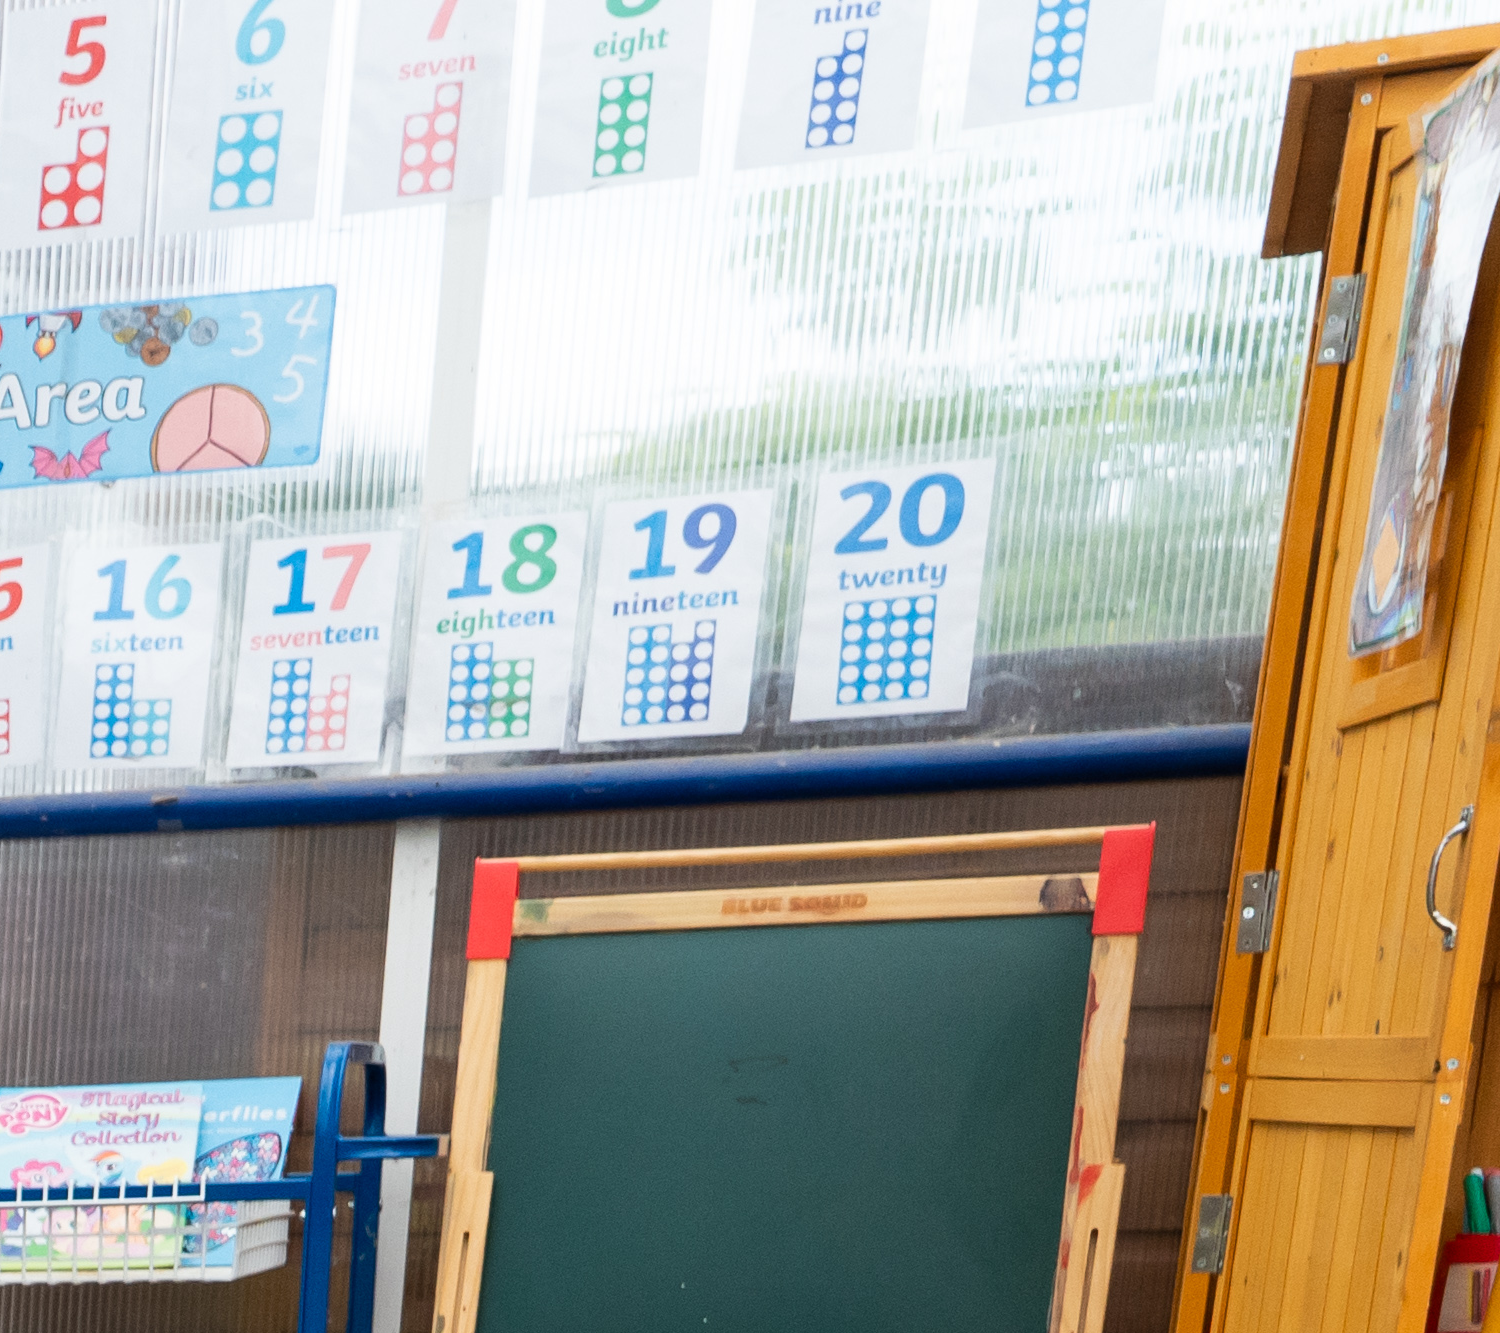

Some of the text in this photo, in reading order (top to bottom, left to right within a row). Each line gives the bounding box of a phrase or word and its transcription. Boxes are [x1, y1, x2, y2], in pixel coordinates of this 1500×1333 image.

[814, 0, 881, 25] nine
[235, 0, 286, 66] 6
[593, 27, 669, 62] eight
[59, 15, 107, 87] 5
[399, 53, 476, 81] seven
[235, 78, 274, 101] six
[56, 98, 104, 130] five
[285, 293, 321, 339] 4
[230, 310, 265, 358] 3
[272, 353, 319, 403] 5
[834, 472, 966, 556] 20
[628, 502, 738, 582] 19
[446, 523, 558, 601] 18
[837, 560, 949, 592] twenty
[93, 553, 193, 621] 16
[272, 543, 371, 616] 17
[612, 586, 739, 618] nineteen
[250, 623, 380, 653] seventeen
[435, 605, 556, 640] eighteen
[90, 632, 184, 655] sixteen
[721, 897, 783, 916] BLUE
[80, 1089, 184, 1111] Magical
[203, 1105, 287, 1123] erflies
[96, 1111, 160, 1129] Story
[71, 1130, 182, 1146] Collection
